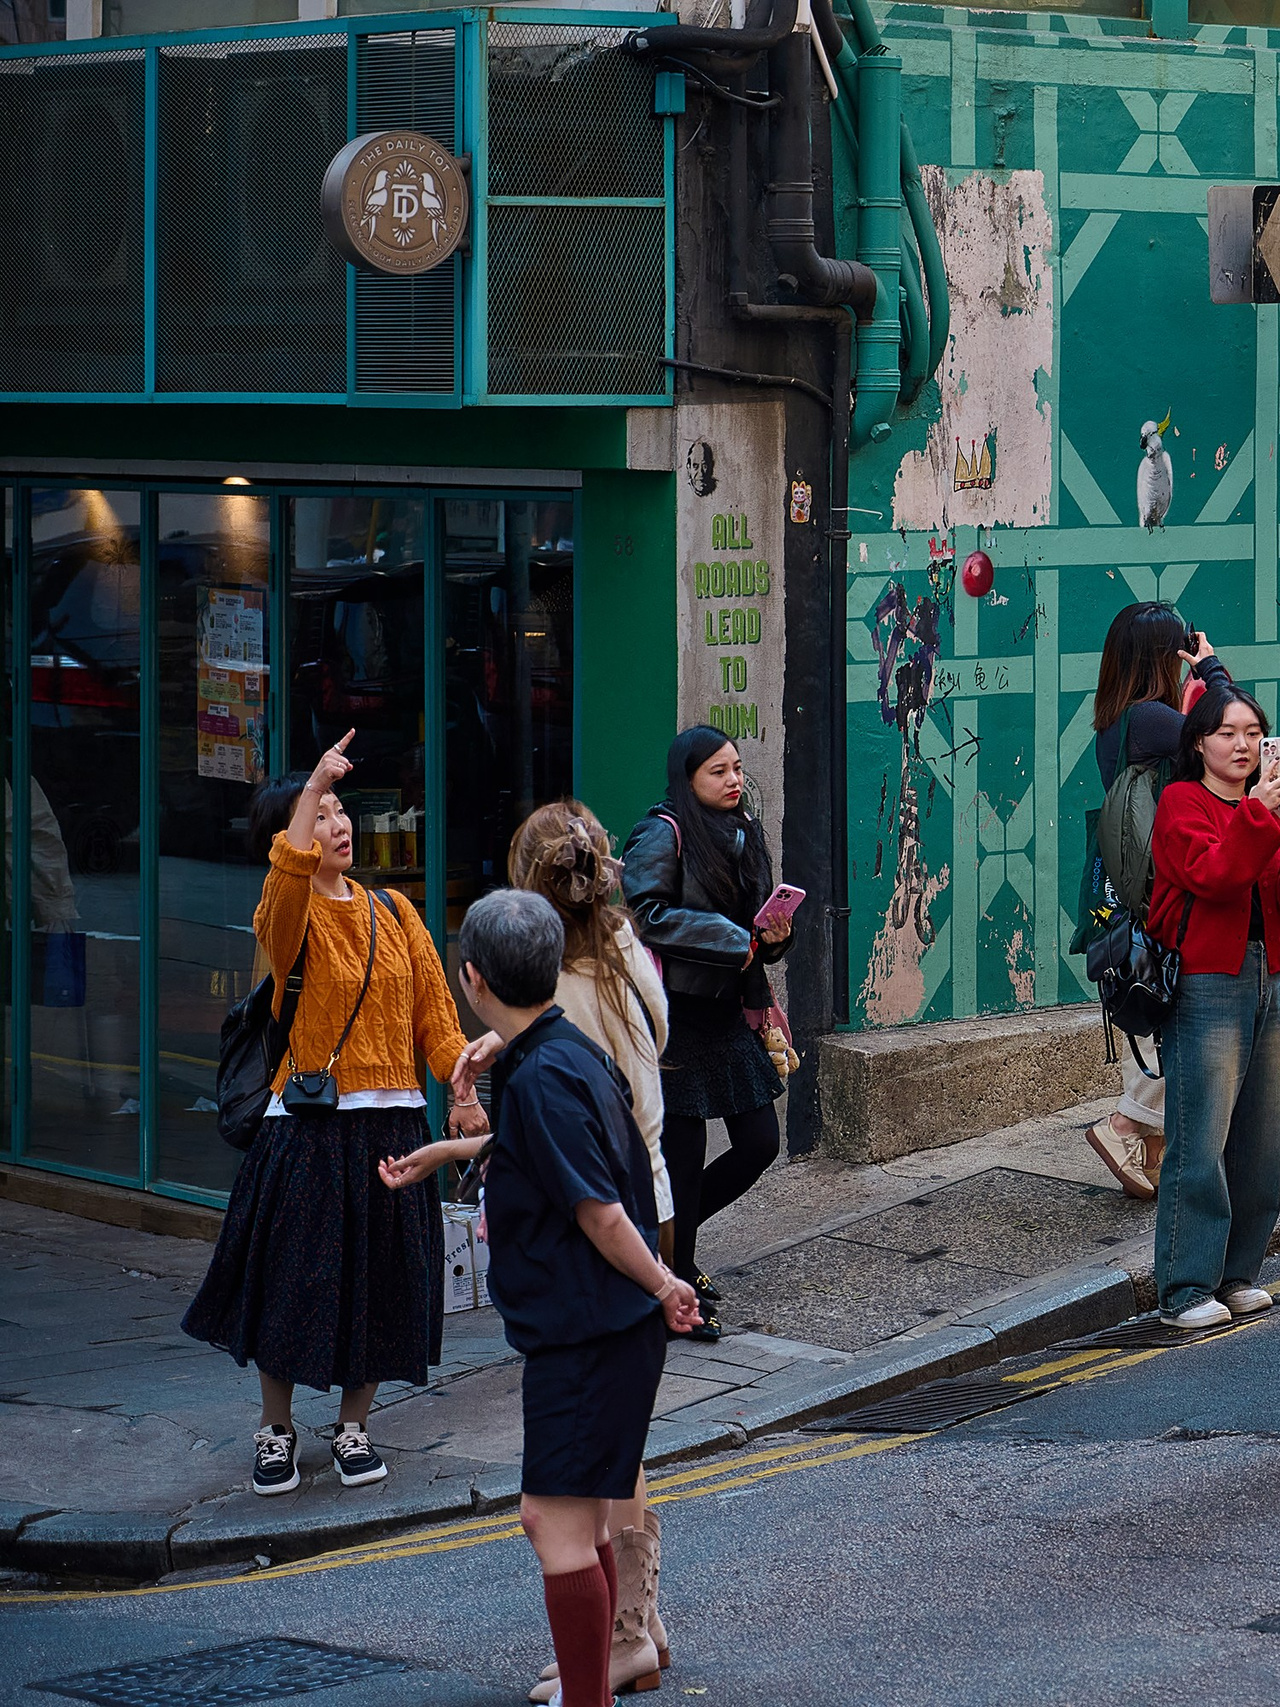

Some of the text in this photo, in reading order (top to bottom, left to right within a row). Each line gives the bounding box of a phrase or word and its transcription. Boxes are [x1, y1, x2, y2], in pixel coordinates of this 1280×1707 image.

[360, 140, 451, 172] THE DAILY TOT
[368, 244, 393, 264] YOUR
[395, 257, 423, 267] DAILY
[711, 512, 753, 550] ALL
[694, 560, 770, 599] ROADS
[704, 608, 762, 646] LEAD
[719, 655, 748, 692] TO
